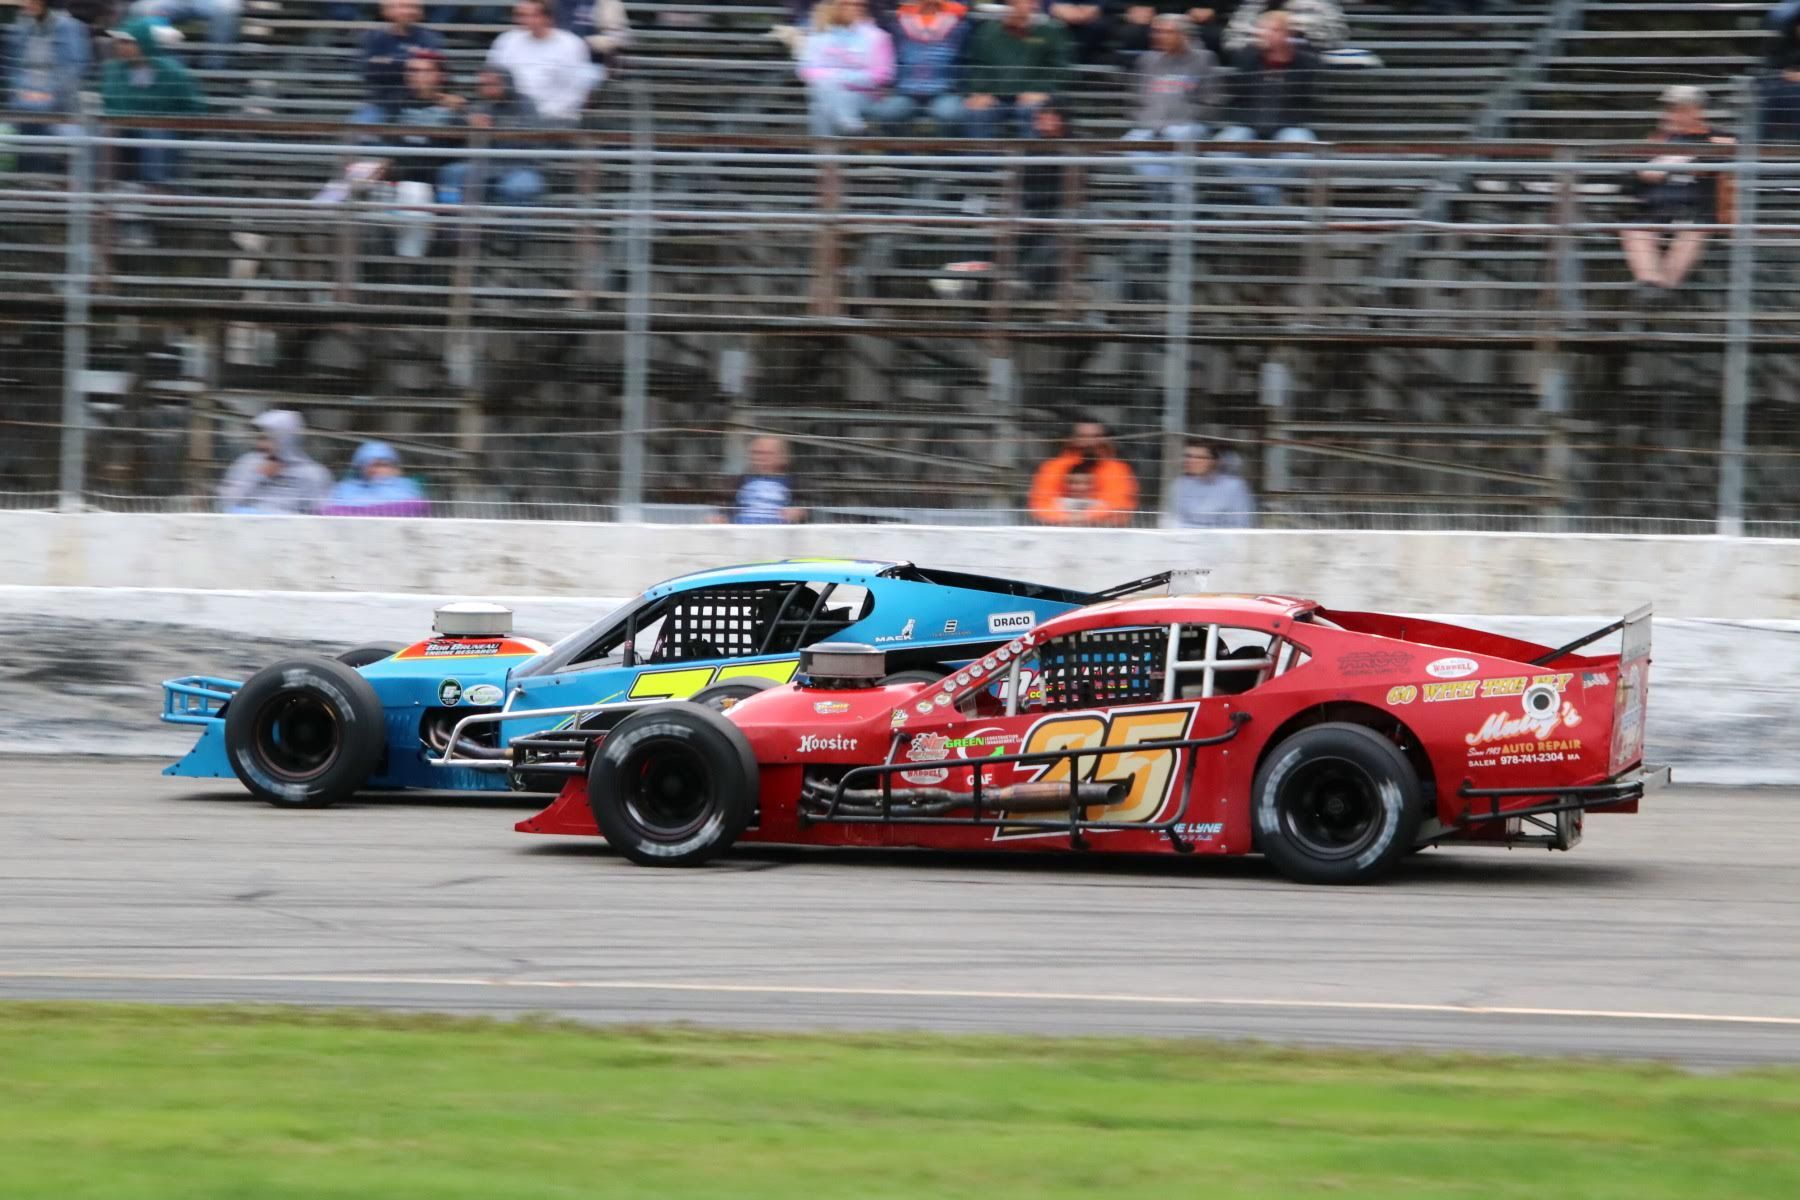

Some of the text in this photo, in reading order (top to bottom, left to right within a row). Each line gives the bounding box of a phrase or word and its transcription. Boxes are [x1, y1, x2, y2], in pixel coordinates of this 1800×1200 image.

[993, 616, 1030, 628] DRACO
[875, 635, 913, 643] MACK
[1386, 685, 1418, 705] GO
[1422, 680, 1481, 702] WITH
[1481, 677, 1528, 699] THE
[796, 733, 858, 752] Hoosier
[944, 737, 985, 748] GREEN
[1501, 739, 1582, 754] AUTO REPAIR
[1500, 752, 1564, 765] 978-741-2304
[992, 702, 1200, 841] 25
[1187, 823, 1223, 833] LYNE
